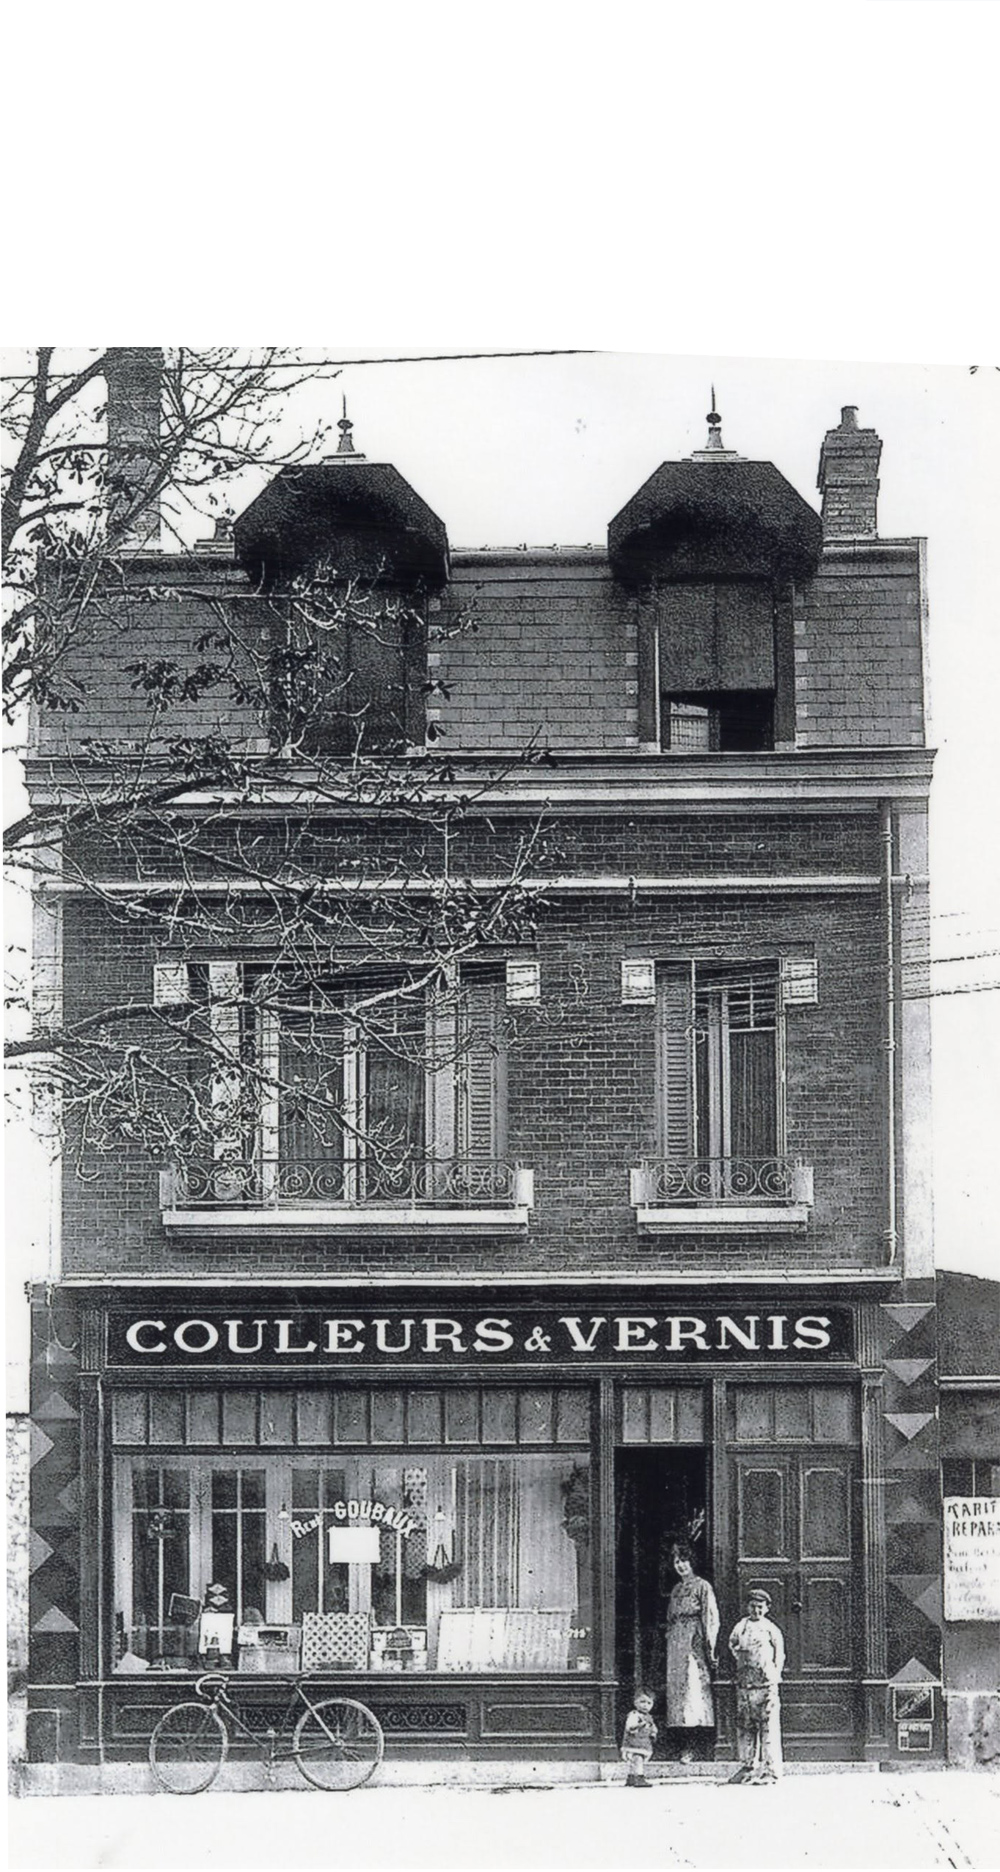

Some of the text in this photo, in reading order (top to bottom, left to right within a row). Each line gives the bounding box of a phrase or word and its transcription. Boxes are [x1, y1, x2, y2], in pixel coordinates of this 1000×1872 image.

[125, 1315, 832, 1354] COULEURS & VERNIS
[334, 1500, 417, 1538] GOUBAUX
